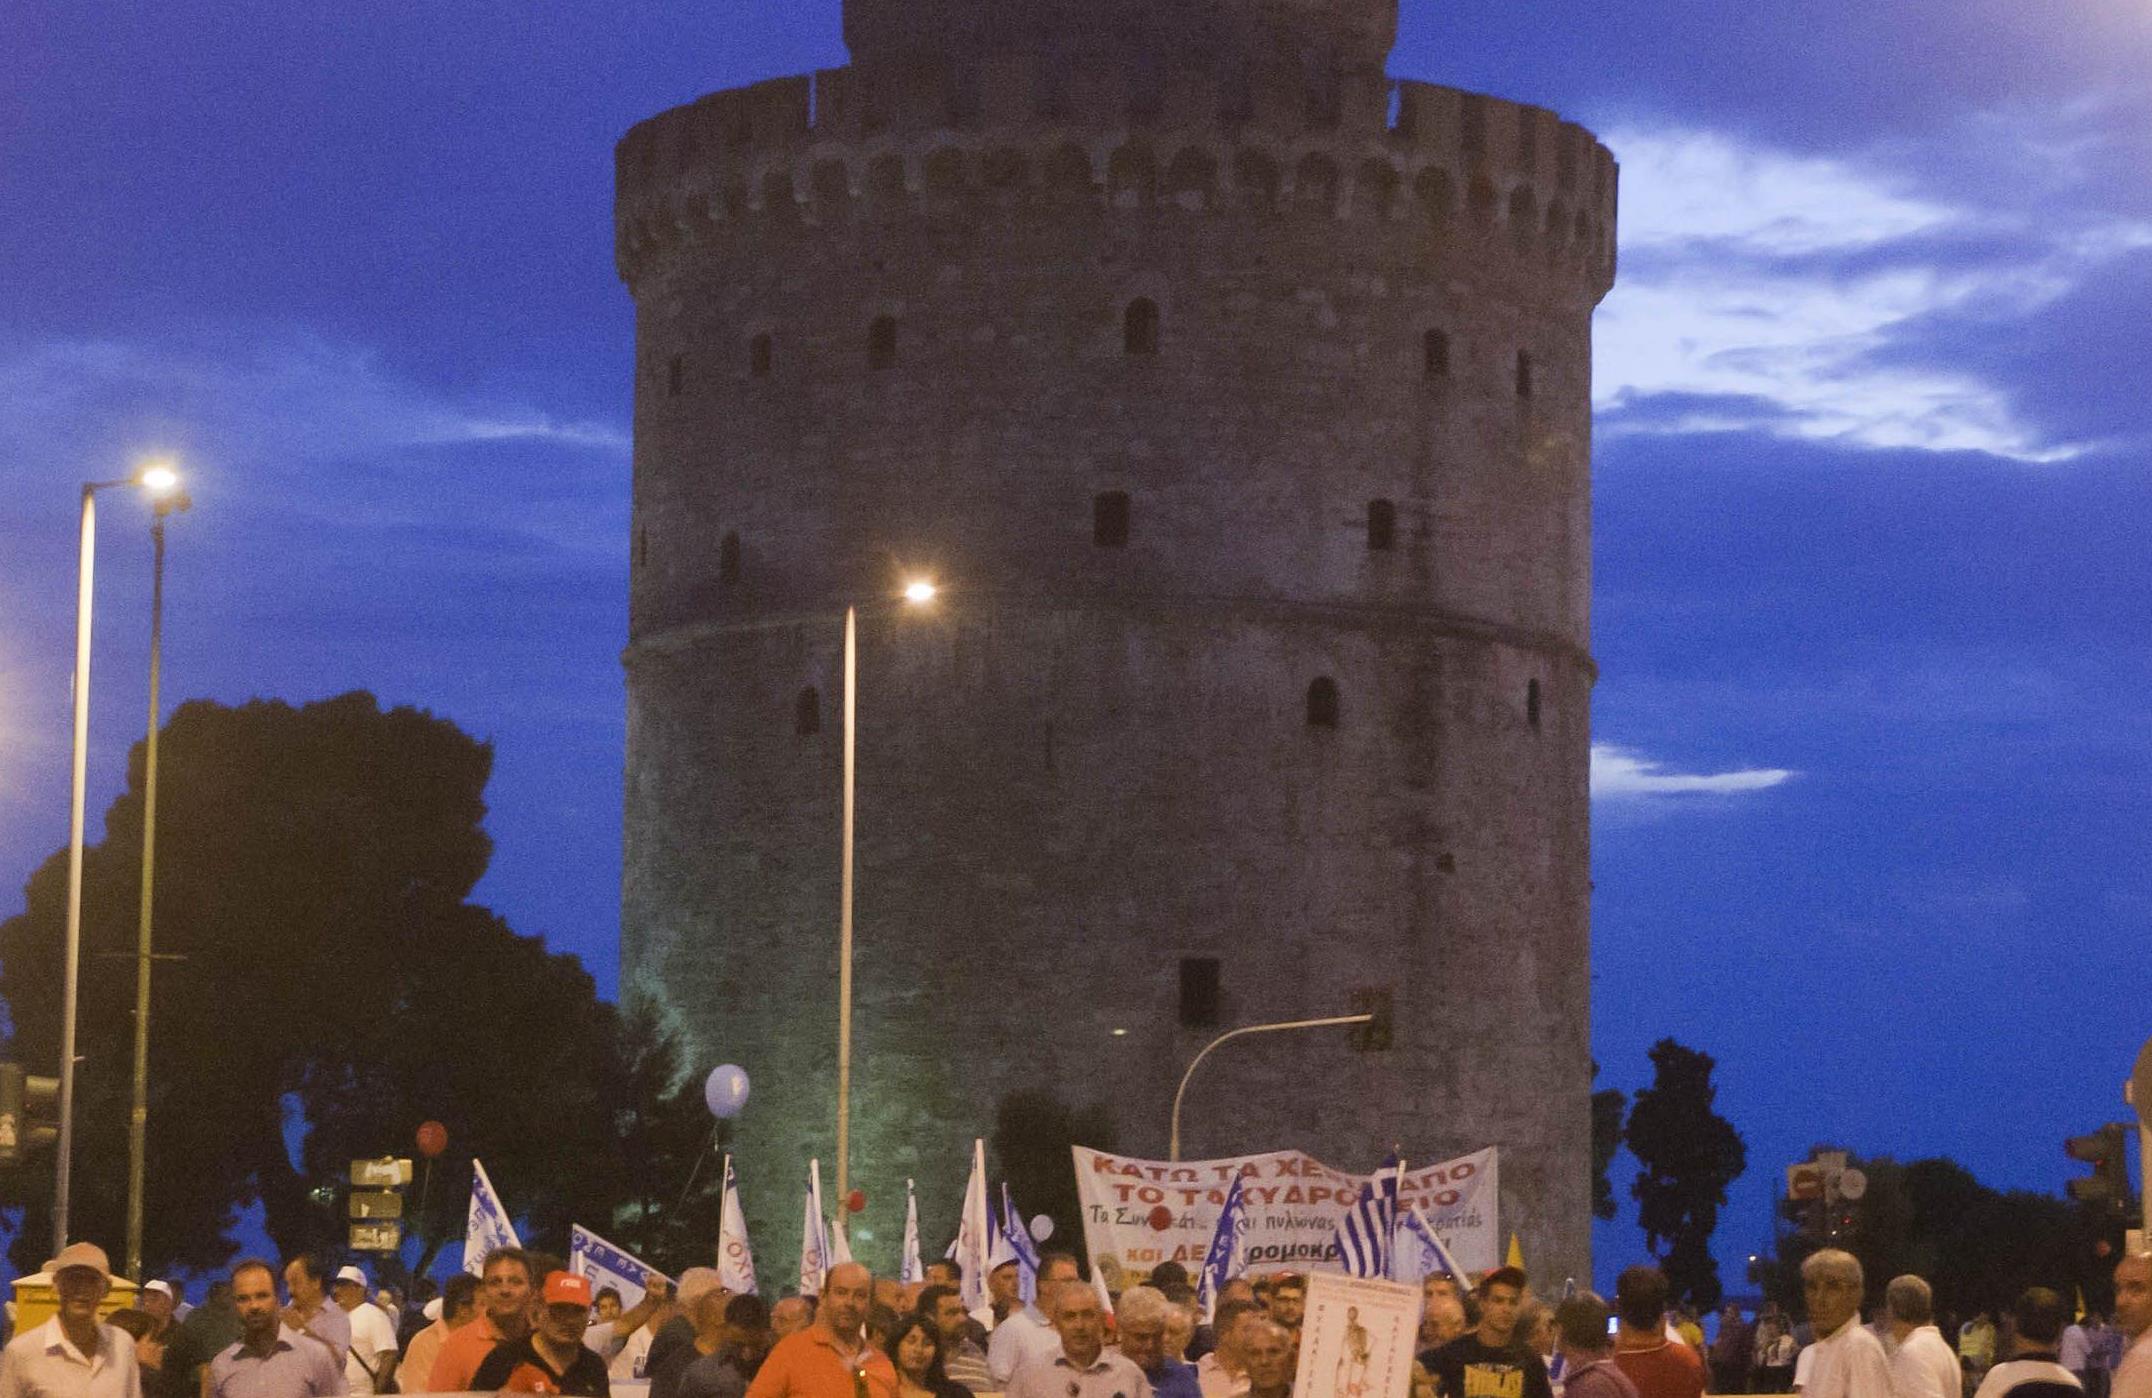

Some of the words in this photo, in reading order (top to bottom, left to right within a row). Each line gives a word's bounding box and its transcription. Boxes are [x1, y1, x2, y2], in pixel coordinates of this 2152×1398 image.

[1093, 1153, 1199, 1183] ΚΑΤΩ
[1212, 1161, 1260, 1181] ΤΑ
[1399, 1163, 1475, 1192] ΑΠΟ
[1113, 1183, 1164, 1204] ΤΟ
[1127, 1248, 1164, 1262] και
[1172, 1244, 1207, 1262] ΔΕ
[1247, 1242, 1338, 1265] ρομοκρ
